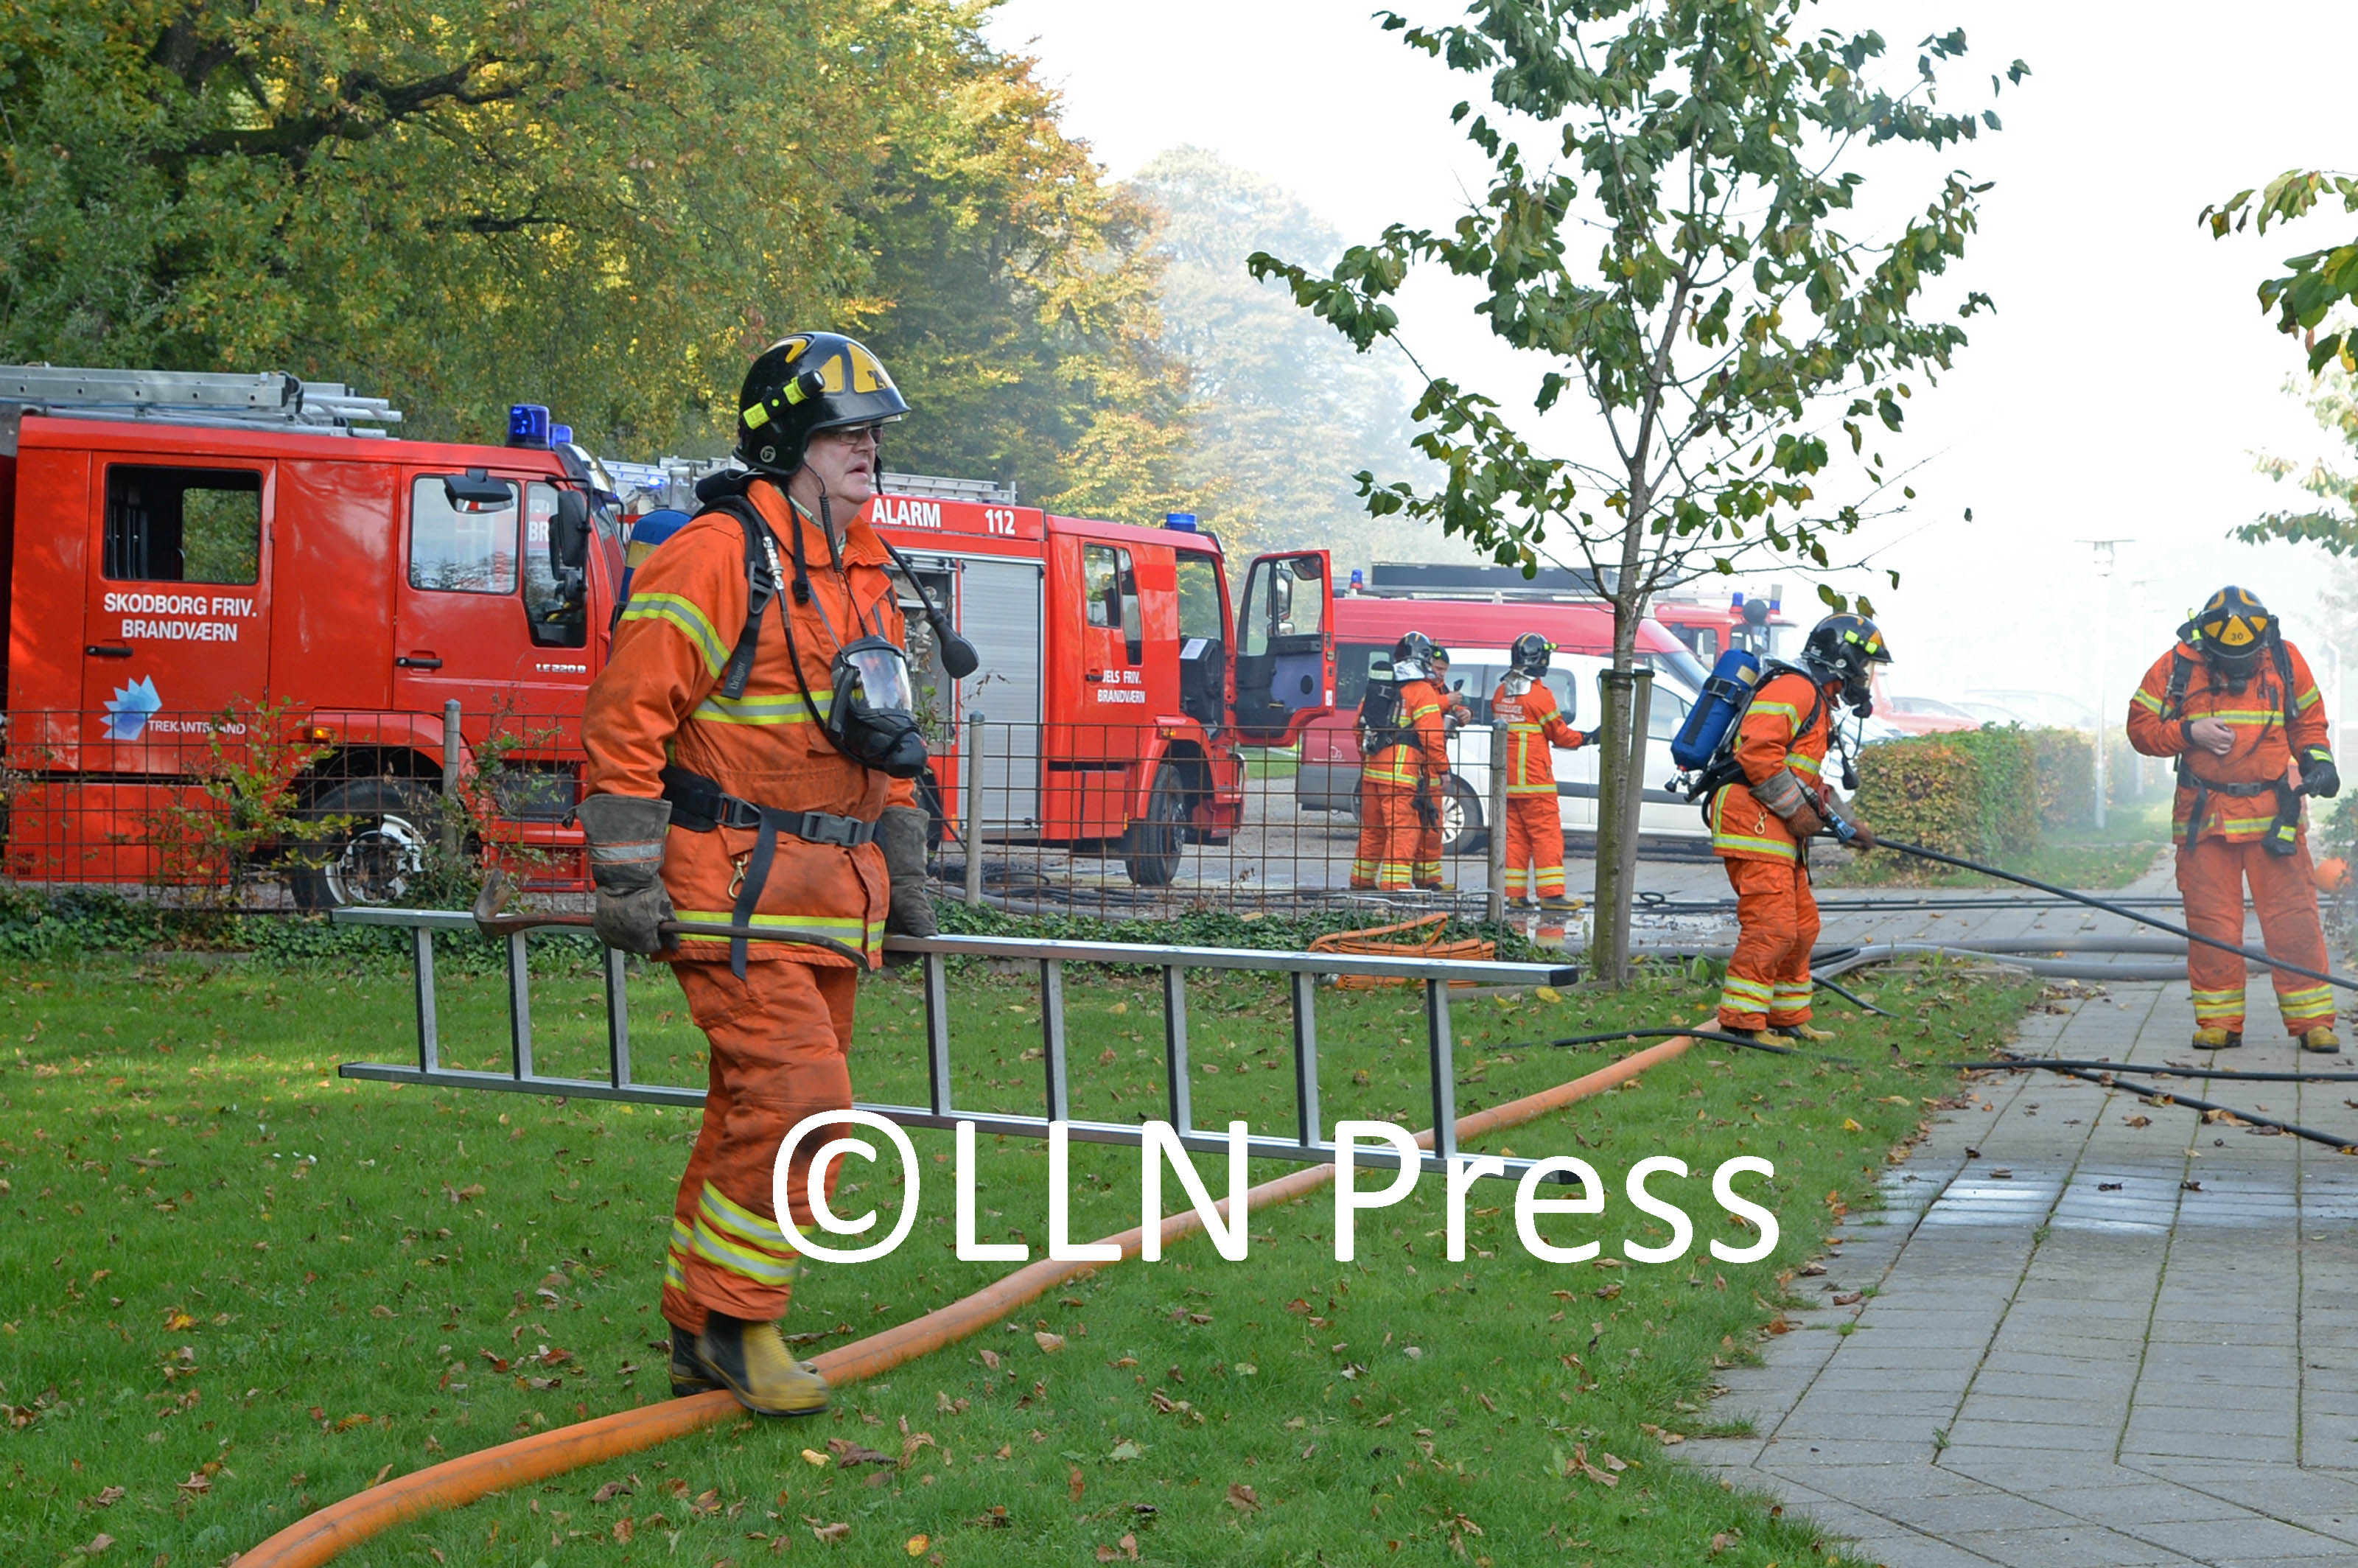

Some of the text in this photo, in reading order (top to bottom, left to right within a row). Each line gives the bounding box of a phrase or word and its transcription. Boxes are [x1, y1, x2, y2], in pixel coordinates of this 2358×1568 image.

[872, 498, 1016, 535] ALARM 112
[103, 592, 257, 617] SKODBORG FRIV.
[122, 619, 238, 642] BRANDVÆRN
[2231, 632, 2244, 642] 30
[1102, 670, 1142, 685] JELS FRIV.
[1097, 689, 1145, 704] BRANDVÆRN
